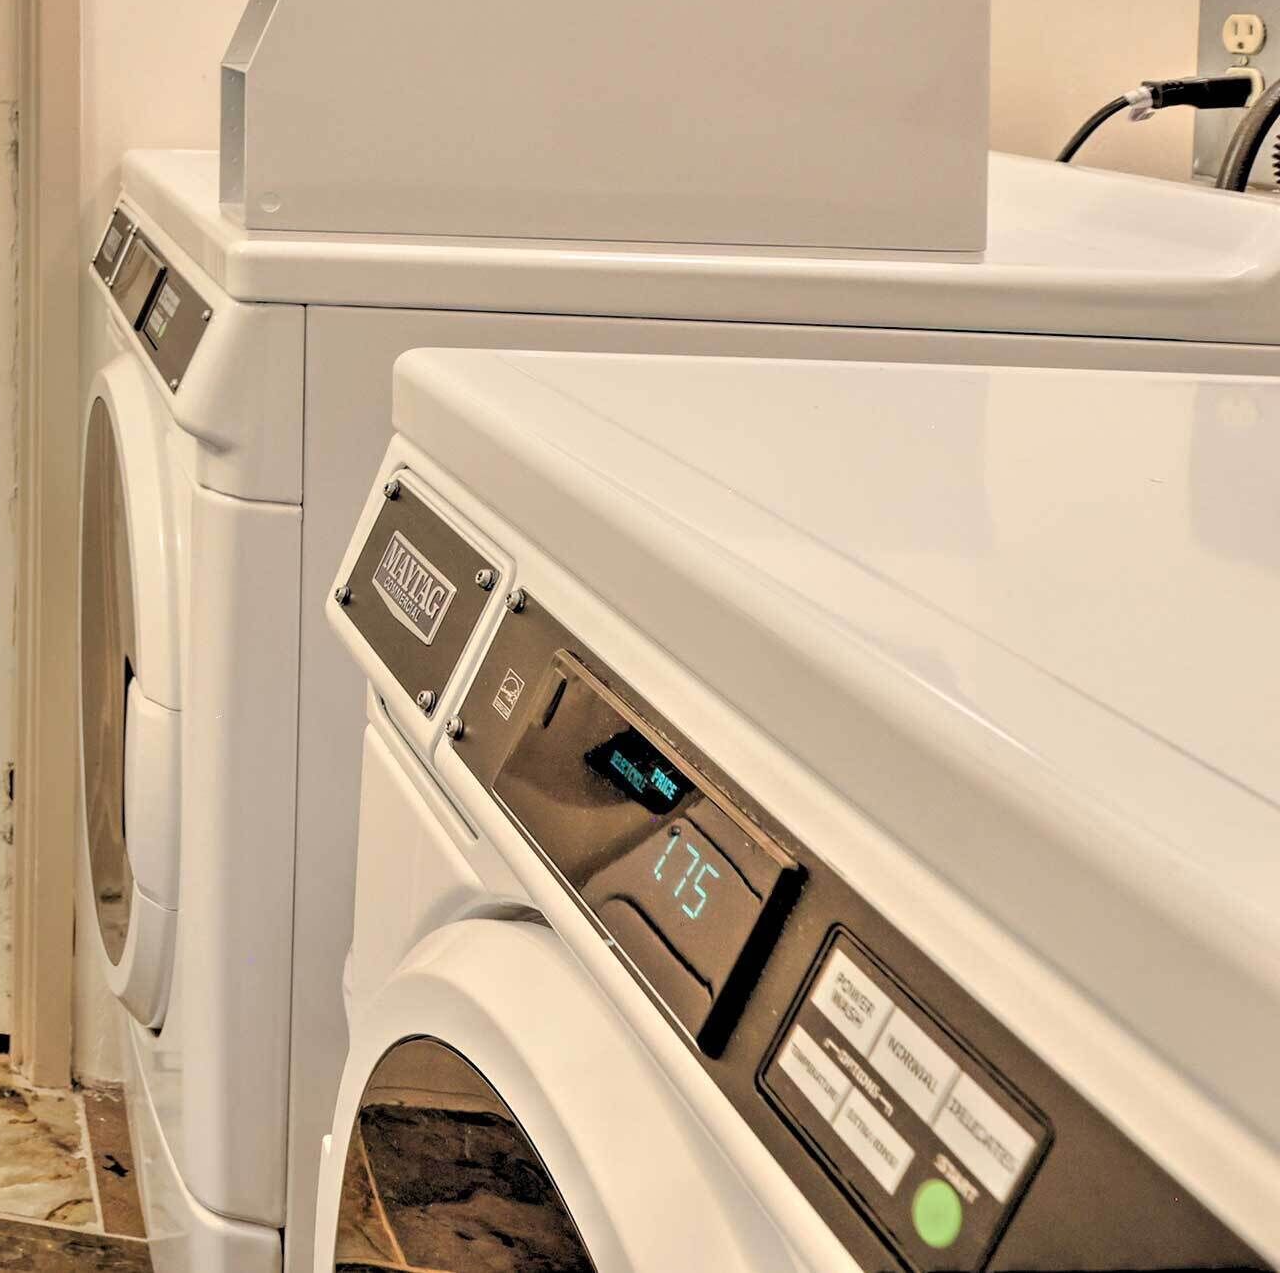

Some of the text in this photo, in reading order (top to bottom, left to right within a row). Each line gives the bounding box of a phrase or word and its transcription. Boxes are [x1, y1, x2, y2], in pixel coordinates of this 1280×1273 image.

[382, 540, 446, 619] MAYTAG
[383, 575, 424, 623] COMMERCIAL
[651, 767, 679, 801] PRICE
[654, 835, 720, 920] 1.75
[830, 989, 866, 1031] WASH
[835, 971, 877, 1019] POWER
[886, 1035, 940, 1095] NORMAL
